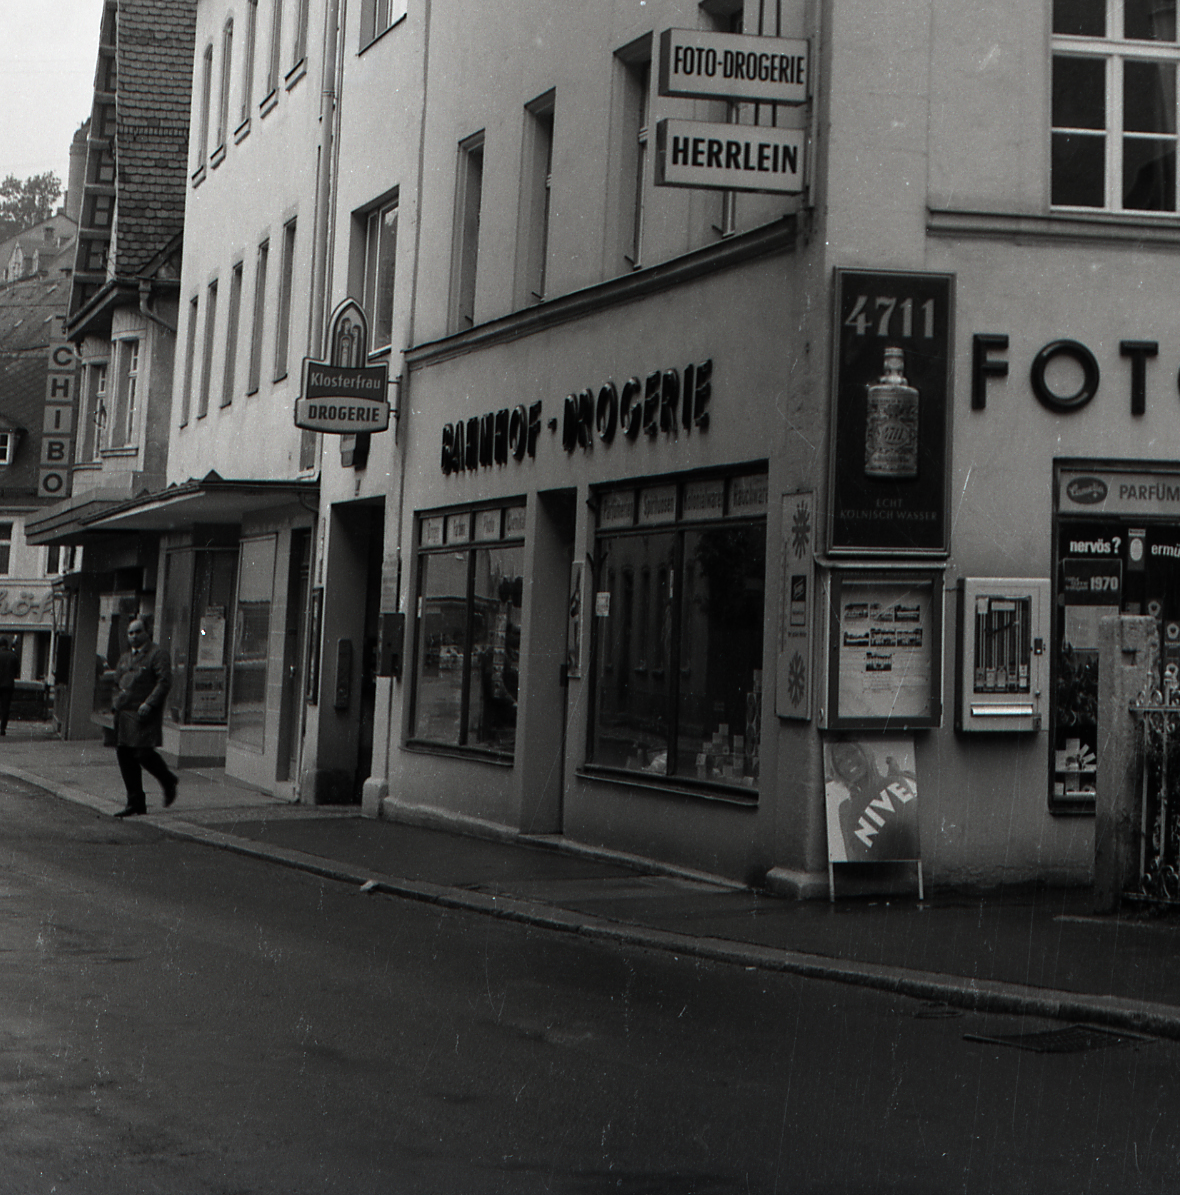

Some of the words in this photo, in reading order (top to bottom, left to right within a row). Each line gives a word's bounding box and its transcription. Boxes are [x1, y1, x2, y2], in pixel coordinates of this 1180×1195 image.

[674, 46, 805, 84] FOTO-DROGERIE
[671, 136, 798, 174] HERRLEIN
[844, 295, 936, 339] 4711
[310, 372, 381, 390] Klosterfrau
[308, 404, 380, 422] DROGERIE
[896, 510, 938, 521] WASSER
[1090, 576, 1119, 591] 1970
